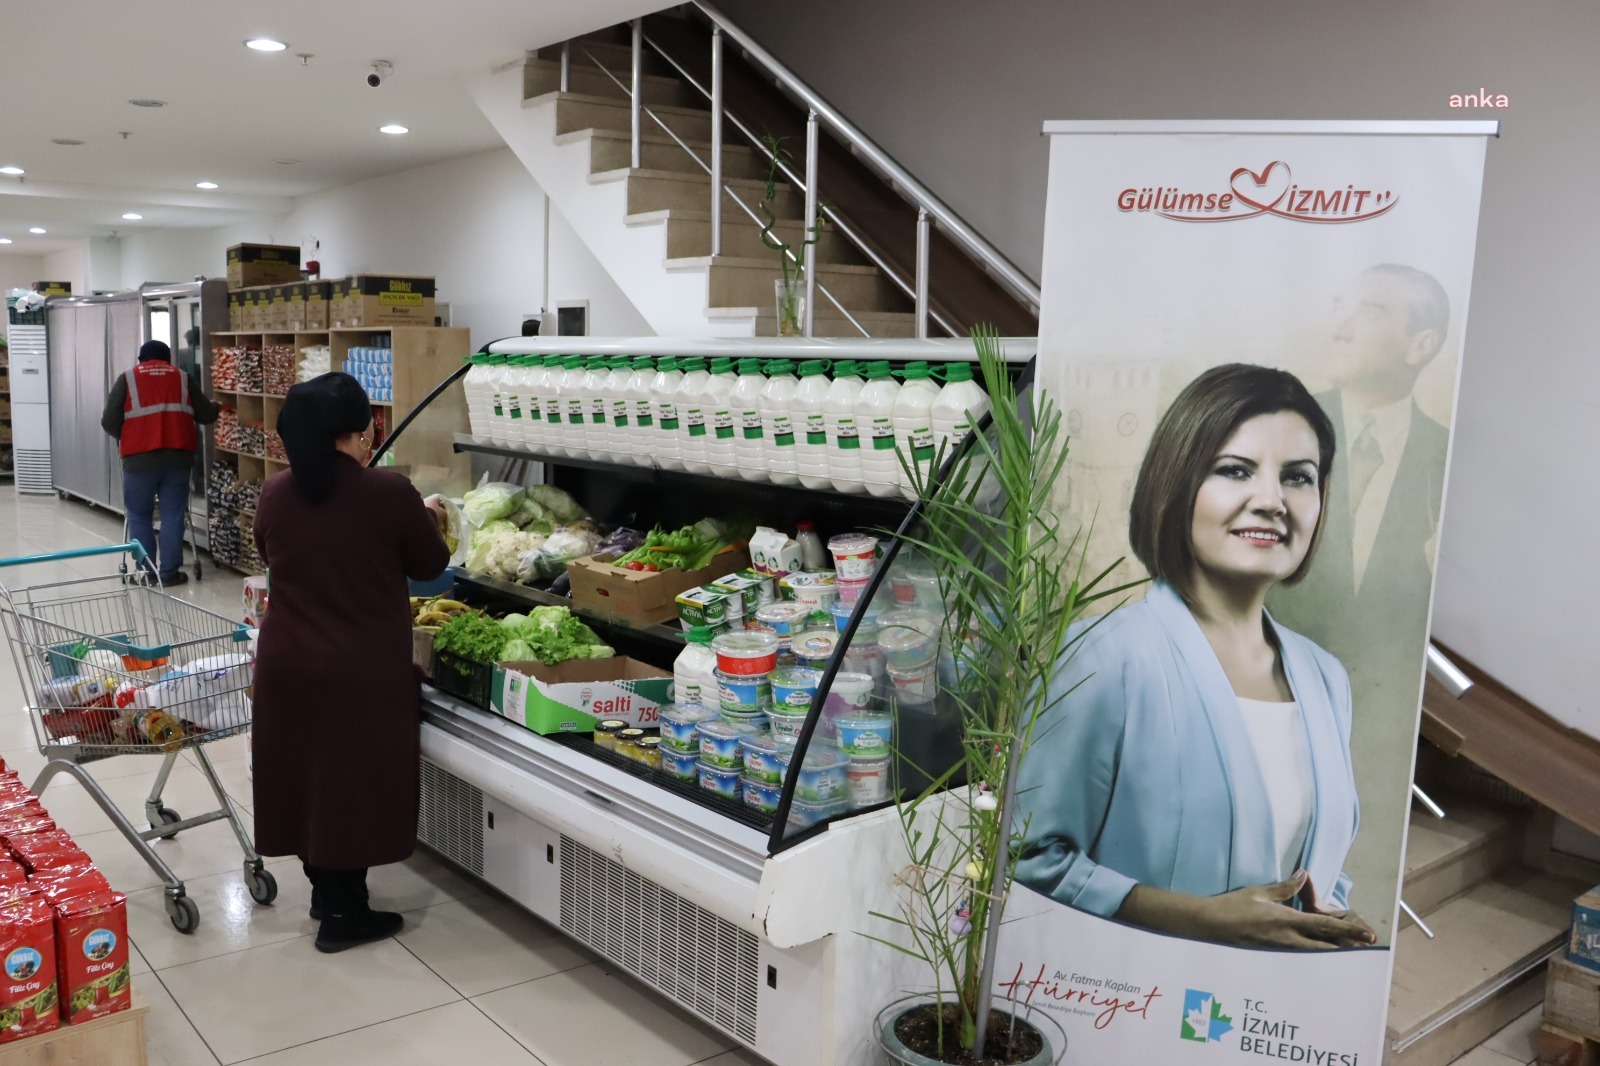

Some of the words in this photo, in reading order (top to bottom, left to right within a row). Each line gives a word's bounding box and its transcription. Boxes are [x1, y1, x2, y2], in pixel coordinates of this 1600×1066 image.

[1117, 187, 1234, 211] Gülümse
[1286, 185, 1371, 213] İZMİT
[998, 962, 1164, 1030] Hürriyet
[1053, 970, 1068, 982] Av.
[1070, 973, 1102, 987] Fatma
[1104, 978, 1141, 994] Kaplan
[1243, 998, 1268, 1014] T.C.
[1242, 1013, 1300, 1041] İZMİT
